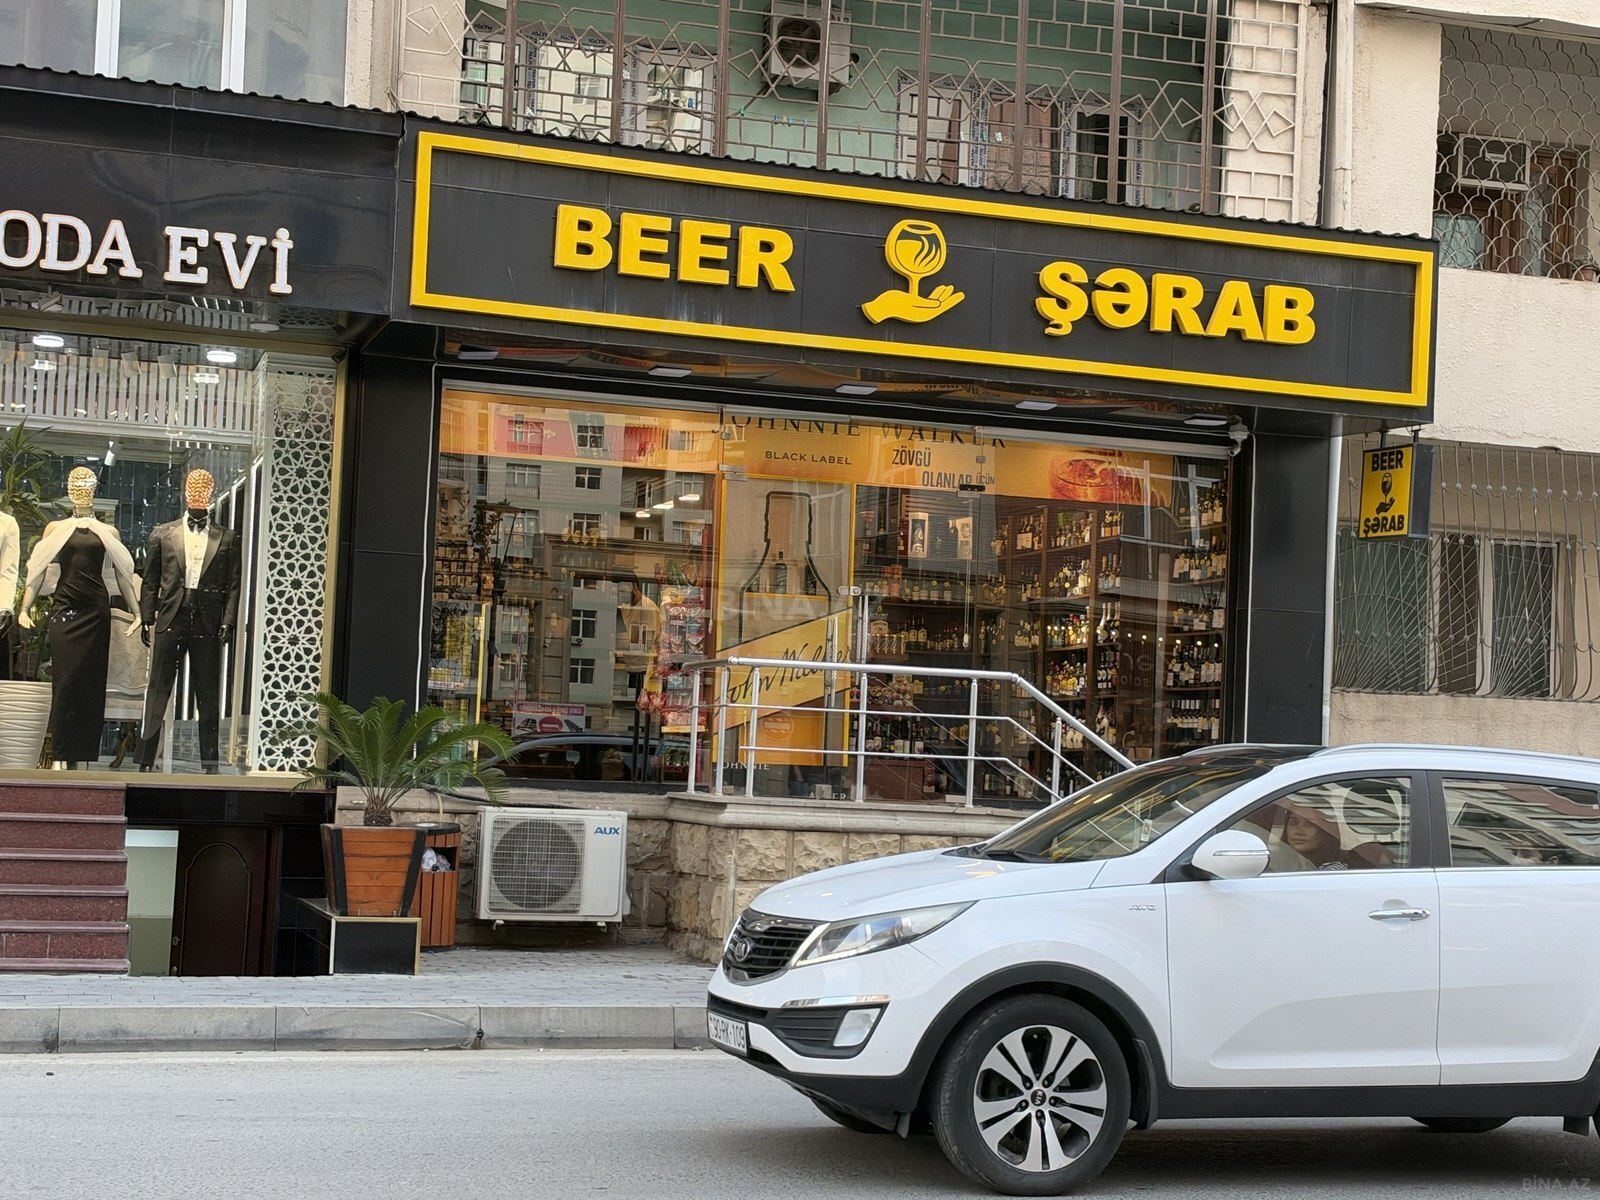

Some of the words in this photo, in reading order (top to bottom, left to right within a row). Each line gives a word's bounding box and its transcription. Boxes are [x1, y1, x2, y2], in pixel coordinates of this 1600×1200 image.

[0, 210, 143, 278] ODA
[163, 226, 294, 295] EVİ
[554, 203, 796, 293] BEER
[1035, 261, 1316, 345] ŞƏRAB
[765, 450, 807, 462] BLACK
[811, 454, 853, 466] LABEL
[892, 445, 931, 468] ZÖVGÜ
[1371, 450, 1404, 471] BEER
[1362, 514, 1405, 537] ŞƏRAB
[779, 643, 851, 687] Waler
[714, 761, 770, 771] OHNIE
[594, 827, 620, 835] AUX
